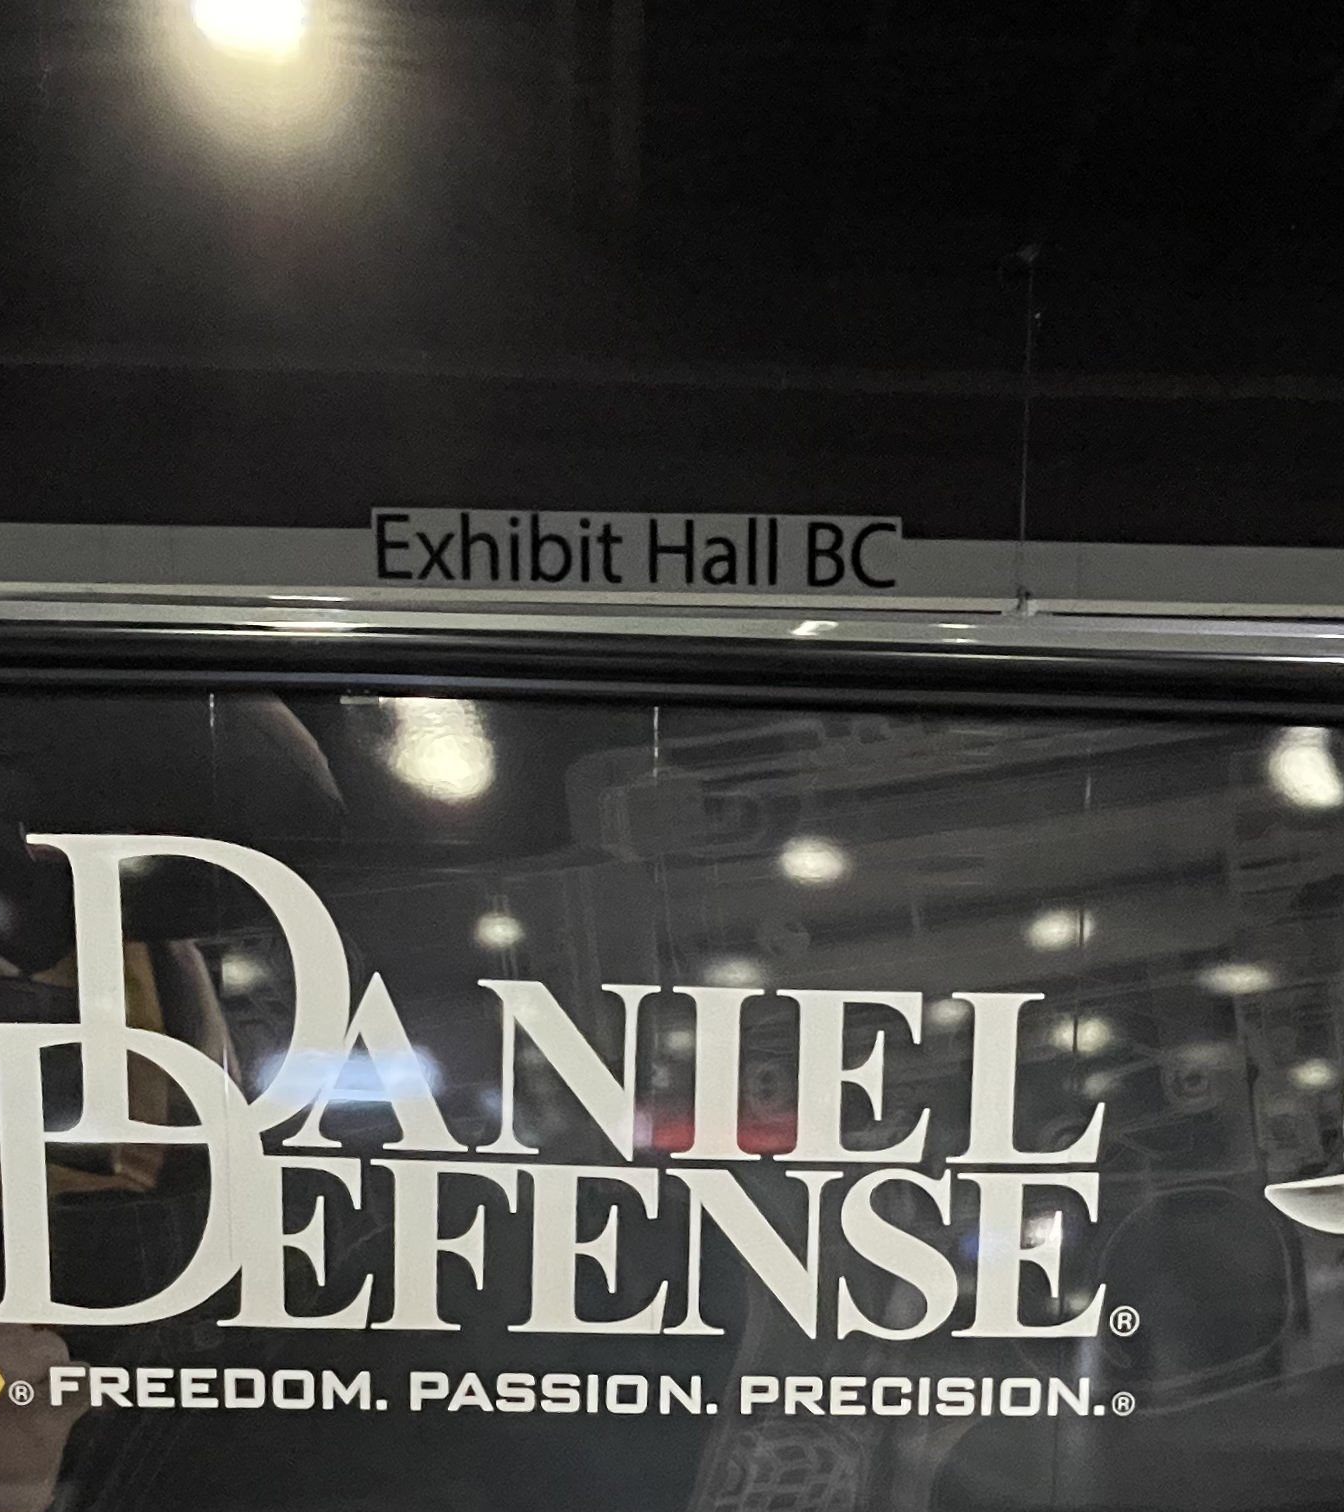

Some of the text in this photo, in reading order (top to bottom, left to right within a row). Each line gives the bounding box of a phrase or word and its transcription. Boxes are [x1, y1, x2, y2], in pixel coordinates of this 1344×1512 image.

[375, 512, 897, 588] Exhibit Hall BC
[25, 833, 1106, 1165] DANIEL
[49, 1366, 388, 1410] FREEDOM.
[410, 1371, 718, 1415] PASSION.
